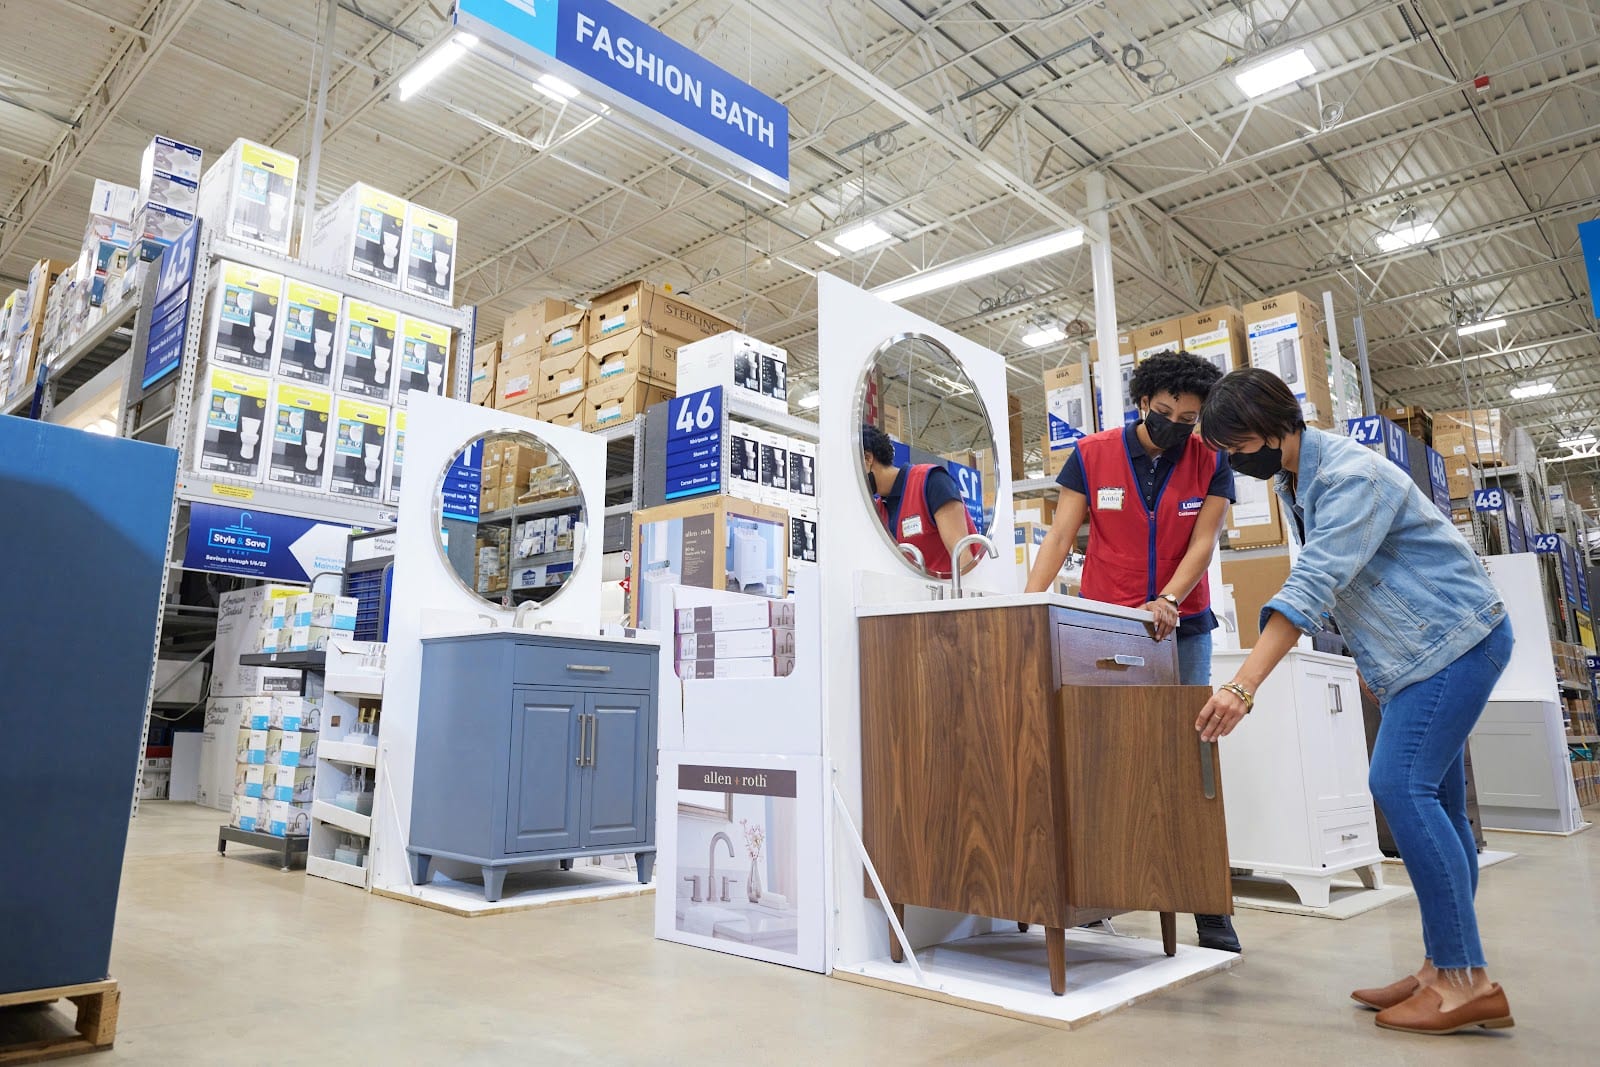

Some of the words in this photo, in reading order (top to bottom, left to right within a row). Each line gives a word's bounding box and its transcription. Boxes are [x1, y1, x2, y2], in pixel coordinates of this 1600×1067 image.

[576, 12, 702, 108] FASHION
[710, 88, 775, 148] BATH
[163, 227, 194, 290] 45
[1262, 302, 1278, 311] USA
[666, 304, 720, 332] STERLING
[1056, 370, 1069, 379] USA
[675, 391, 715, 432] 46
[1350, 418, 1380, 441] 47
[1389, 423, 1404, 463] 47
[1431, 452, 1446, 487] 48
[1475, 490, 1503, 508] 48
[213, 533, 236, 545] Style
[236, 537, 244, 545] &
[244, 538, 267, 549] Save
[1536, 536, 1558, 551] 49
[205, 554, 227, 563] Savings
[227, 557, 249, 566] through
[313, 560, 344, 571] Mainstr
[703, 771, 732, 784] allen
[742, 774, 767, 788] roth
